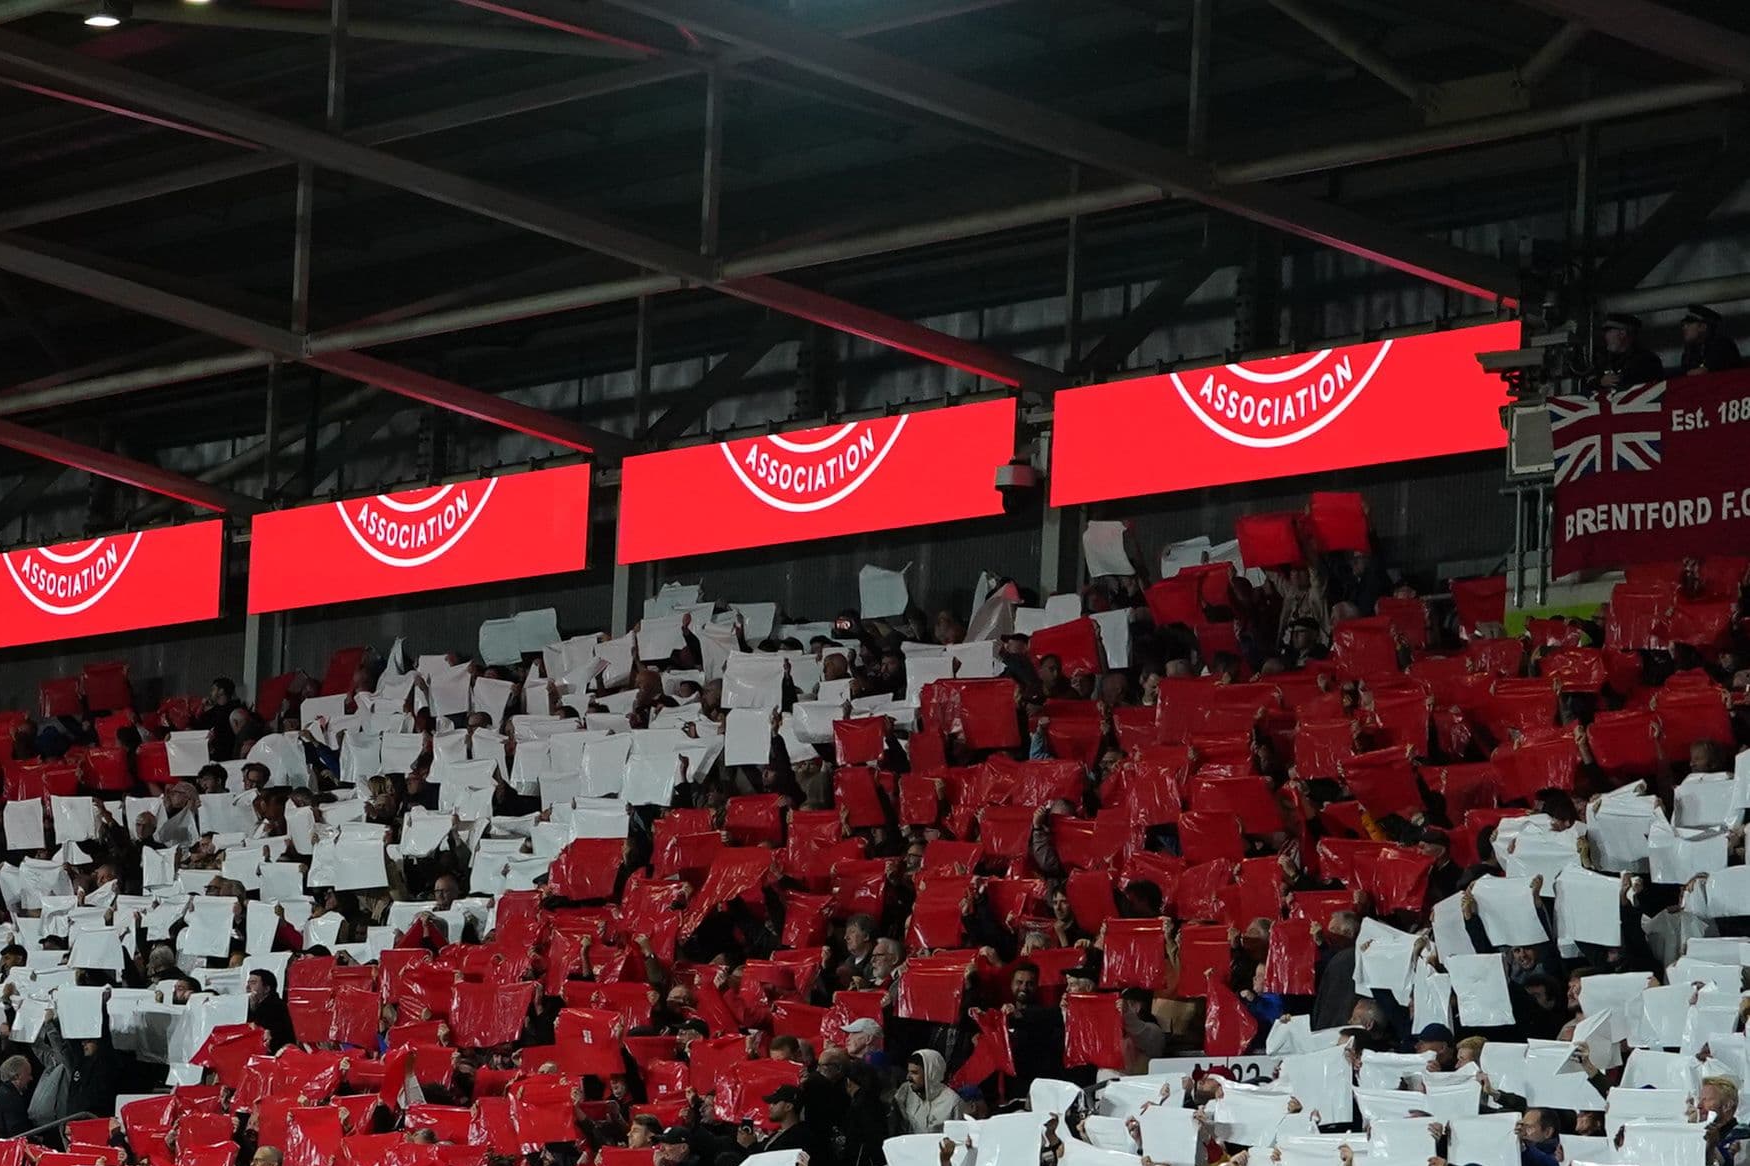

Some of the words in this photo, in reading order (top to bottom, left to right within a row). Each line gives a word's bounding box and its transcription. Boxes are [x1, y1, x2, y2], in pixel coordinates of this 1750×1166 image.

[1200, 355, 1353, 427] ASSOCIATION
[1672, 406, 1710, 432] Est.
[745, 428, 875, 493] ASSOCIATION
[357, 489, 469, 549] ASSOCIATION
[1564, 496, 1712, 543] BRENTFORD
[22, 543, 117, 598] ASSOCIATION
